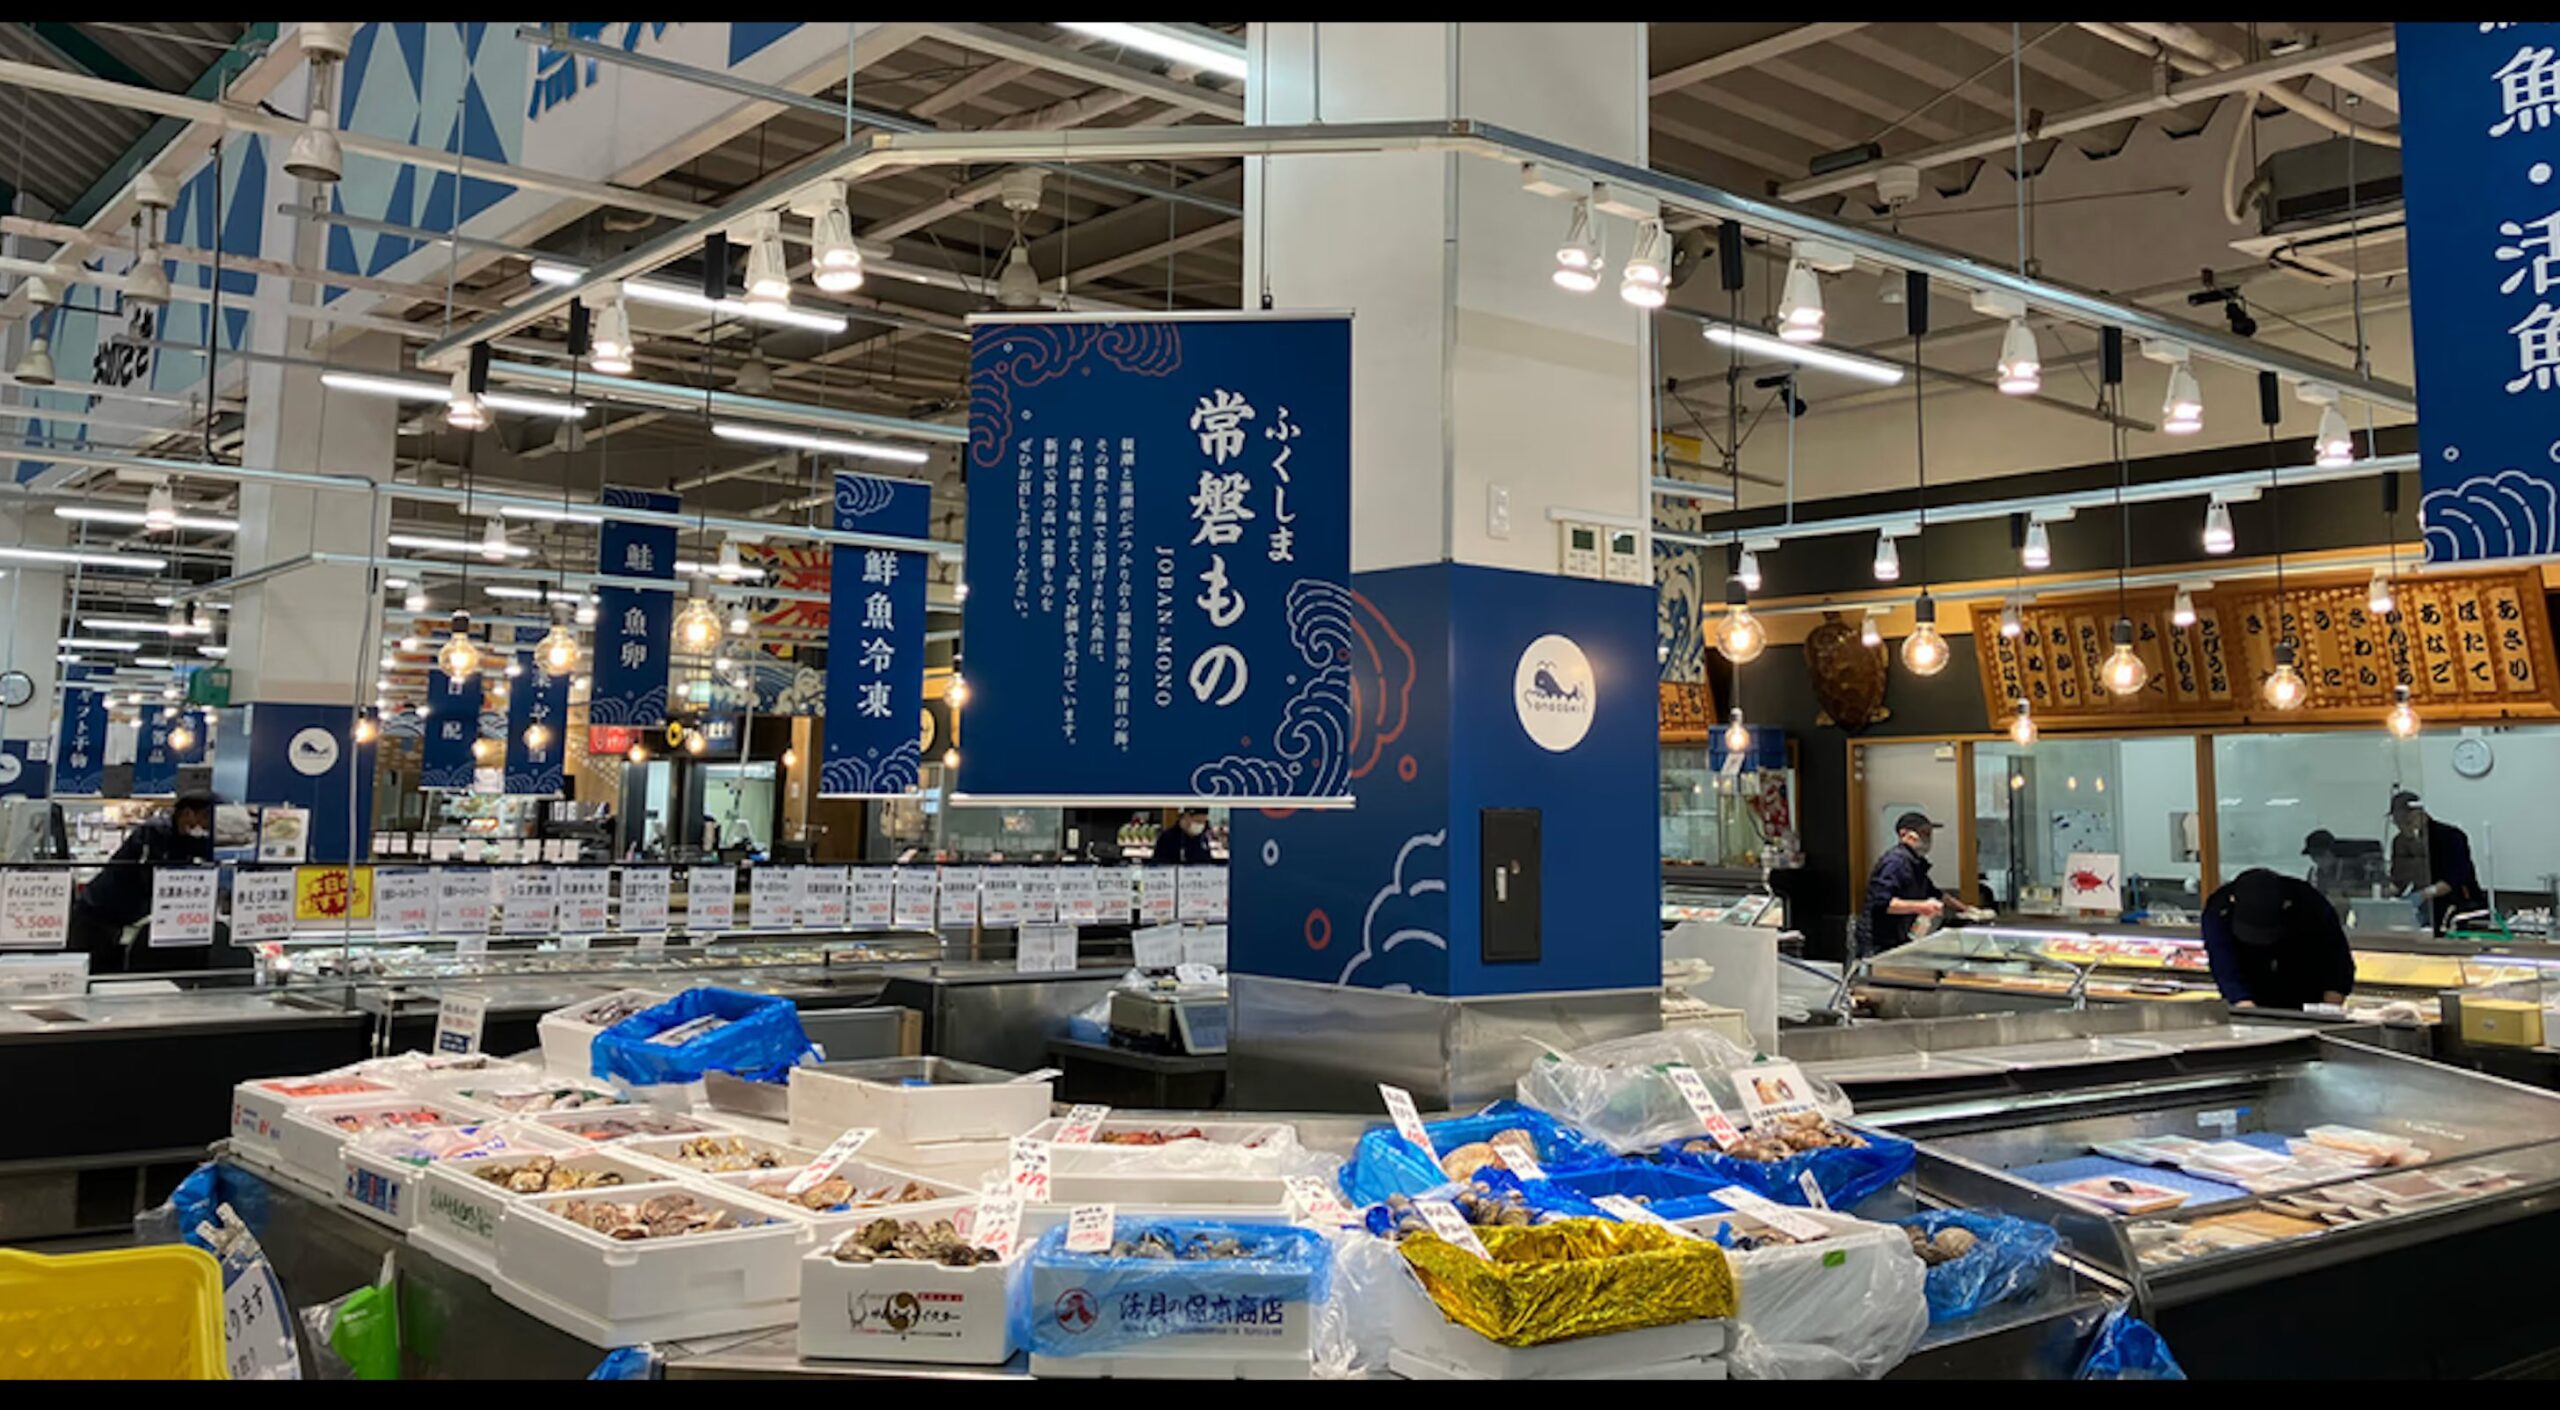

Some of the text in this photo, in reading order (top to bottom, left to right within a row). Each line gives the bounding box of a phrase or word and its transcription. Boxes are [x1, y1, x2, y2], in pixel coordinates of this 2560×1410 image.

[2479, 22, 2560, 394] 魚・活魚
[1264, 406, 1301, 563] ふくしま
[1188, 388, 1257, 706] 常磐もの
[858, 549, 899, 719] 鮮魚冷凍
[2313, 609, 2343, 687] うに
[2349, 607, 2378, 687] さわら
[2420, 602, 2452, 684] あなご
[2457, 599, 2491, 682] ほたて
[2497, 598, 2529, 681] あさり
